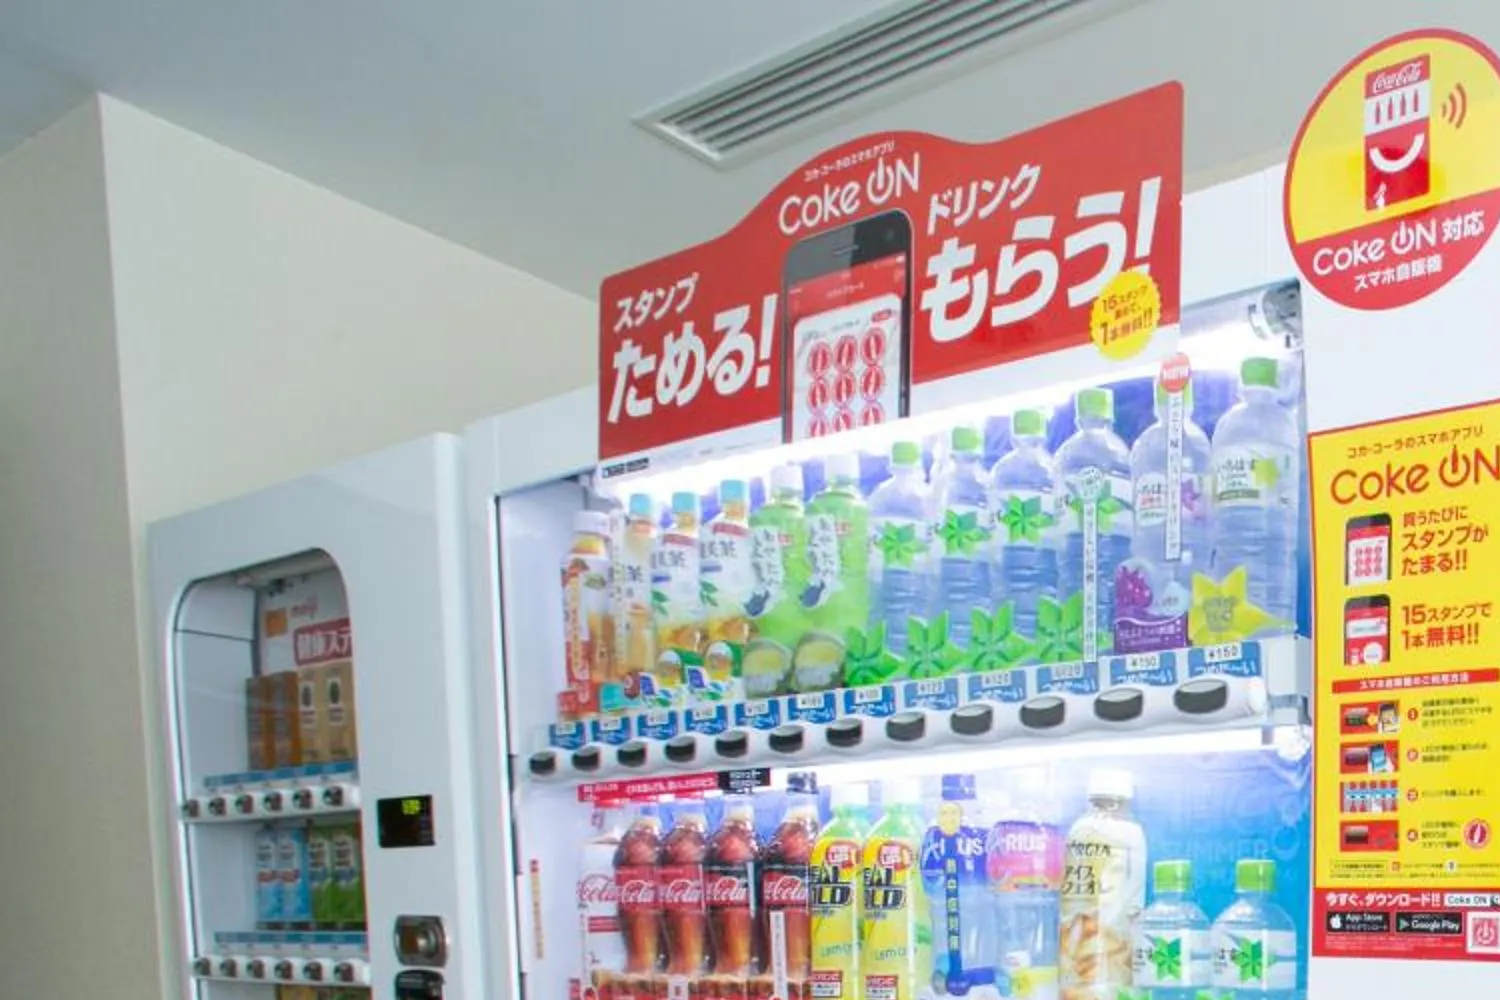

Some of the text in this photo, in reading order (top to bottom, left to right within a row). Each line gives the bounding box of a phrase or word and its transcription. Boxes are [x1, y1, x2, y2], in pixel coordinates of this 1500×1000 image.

[779, 182, 861, 235] Coke
[926, 164, 1041, 234] ドリンク
[1312, 237, 1386, 276] Coke
[1441, 209, 1485, 243] 対応
[613, 272, 699, 333] スタンプ
[1330, 461, 1430, 505] Coke
[1401, 524, 1489, 552] スタンプが
[1402, 505, 1469, 529] 買うたびに
[1401, 602, 1492, 626] 15スタンプで
